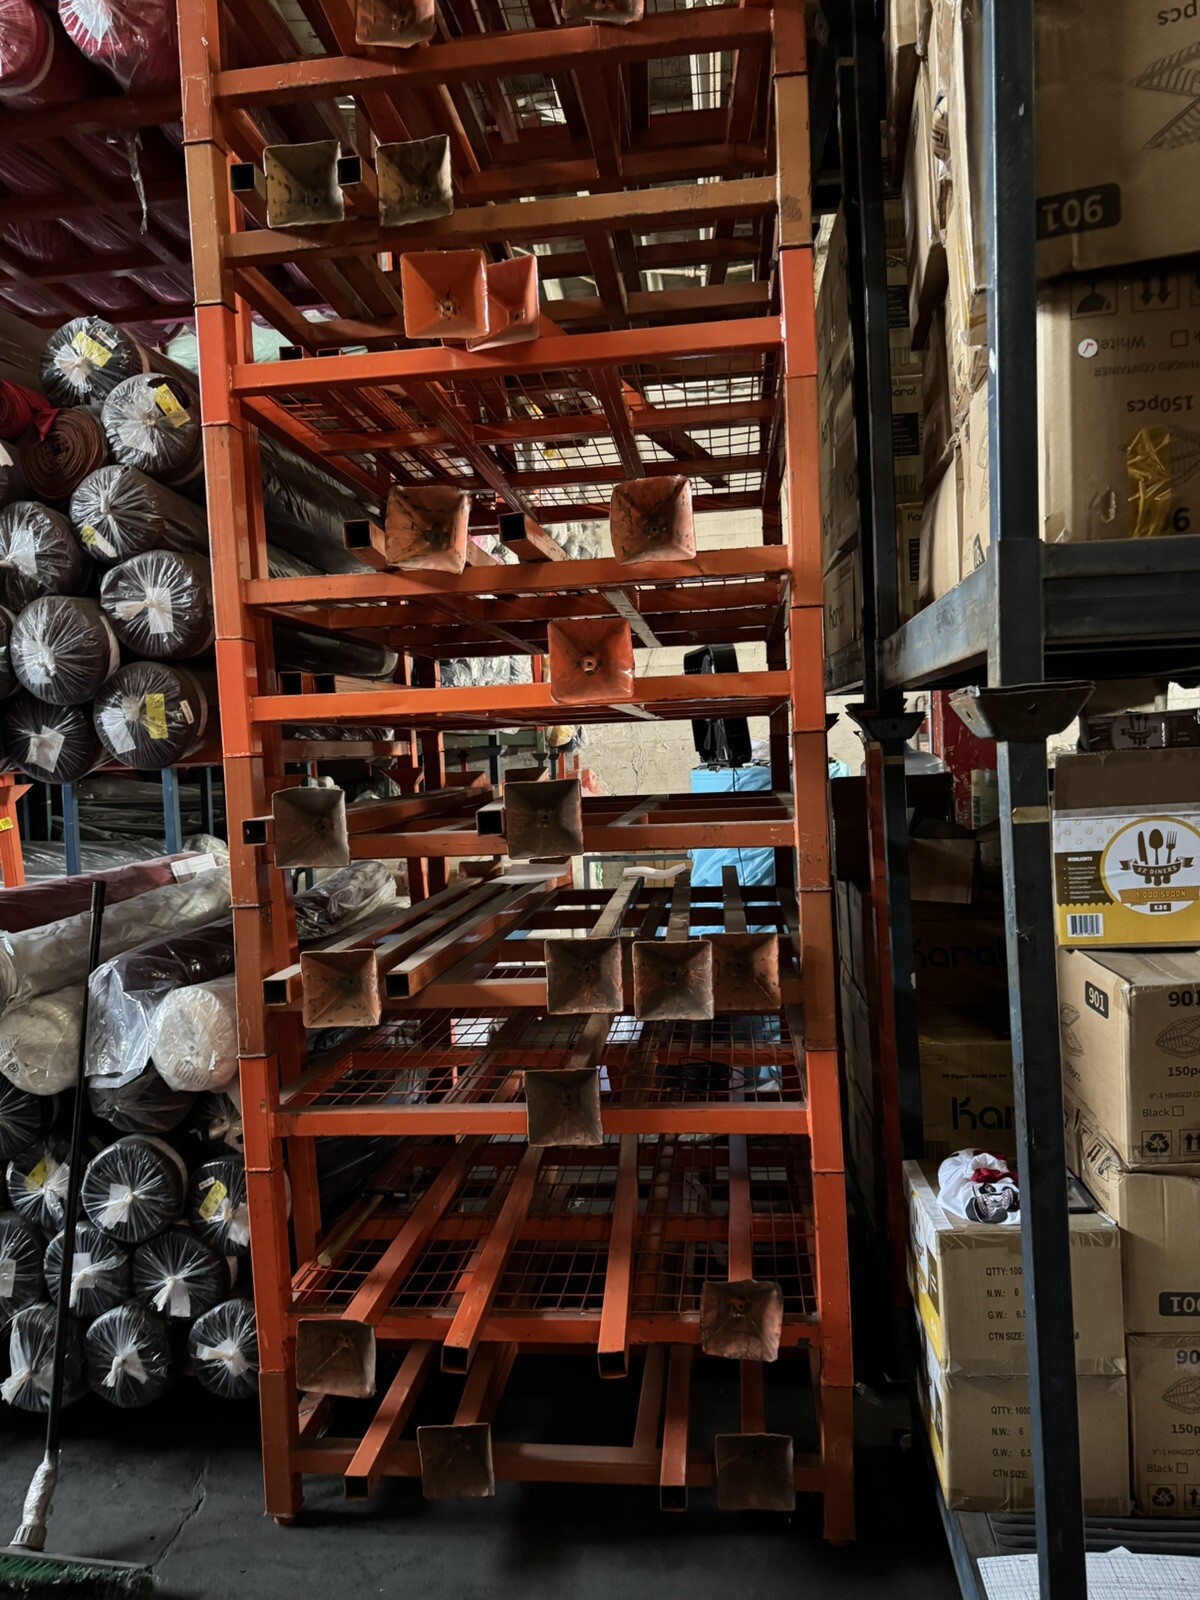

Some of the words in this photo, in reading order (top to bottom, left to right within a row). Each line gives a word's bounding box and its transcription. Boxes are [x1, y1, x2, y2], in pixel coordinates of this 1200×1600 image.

[1101, 336, 1147, 351] White
[1094, 363, 1156, 377] CONTAINER
[1126, 394, 1195, 413] 150pcs
[1150, 865, 1178, 875] DINERS
[1160, 890, 1187, 899] SPOON
[1089, 987, 1105, 1012] 901
[1142, 1107, 1170, 1118] Black
[985, 1266, 1008, 1276] QTTY:
[986, 1288, 1006, 1298] N.W.:
[1170, 1296, 1200, 1313] 01
[987, 1310, 1007, 1319] G.W.:
[988, 1332, 1004, 1341] CTN
[1005, 1332, 1025, 1341] SIZE:
[991, 1405, 1014, 1415] QTTY:
[991, 1427, 1011, 1436] N.W.:
[992, 1447, 1012, 1457] G.W.:
[992, 1469, 1009, 1478] CTN
[1147, 1463, 1174, 1474] Black
